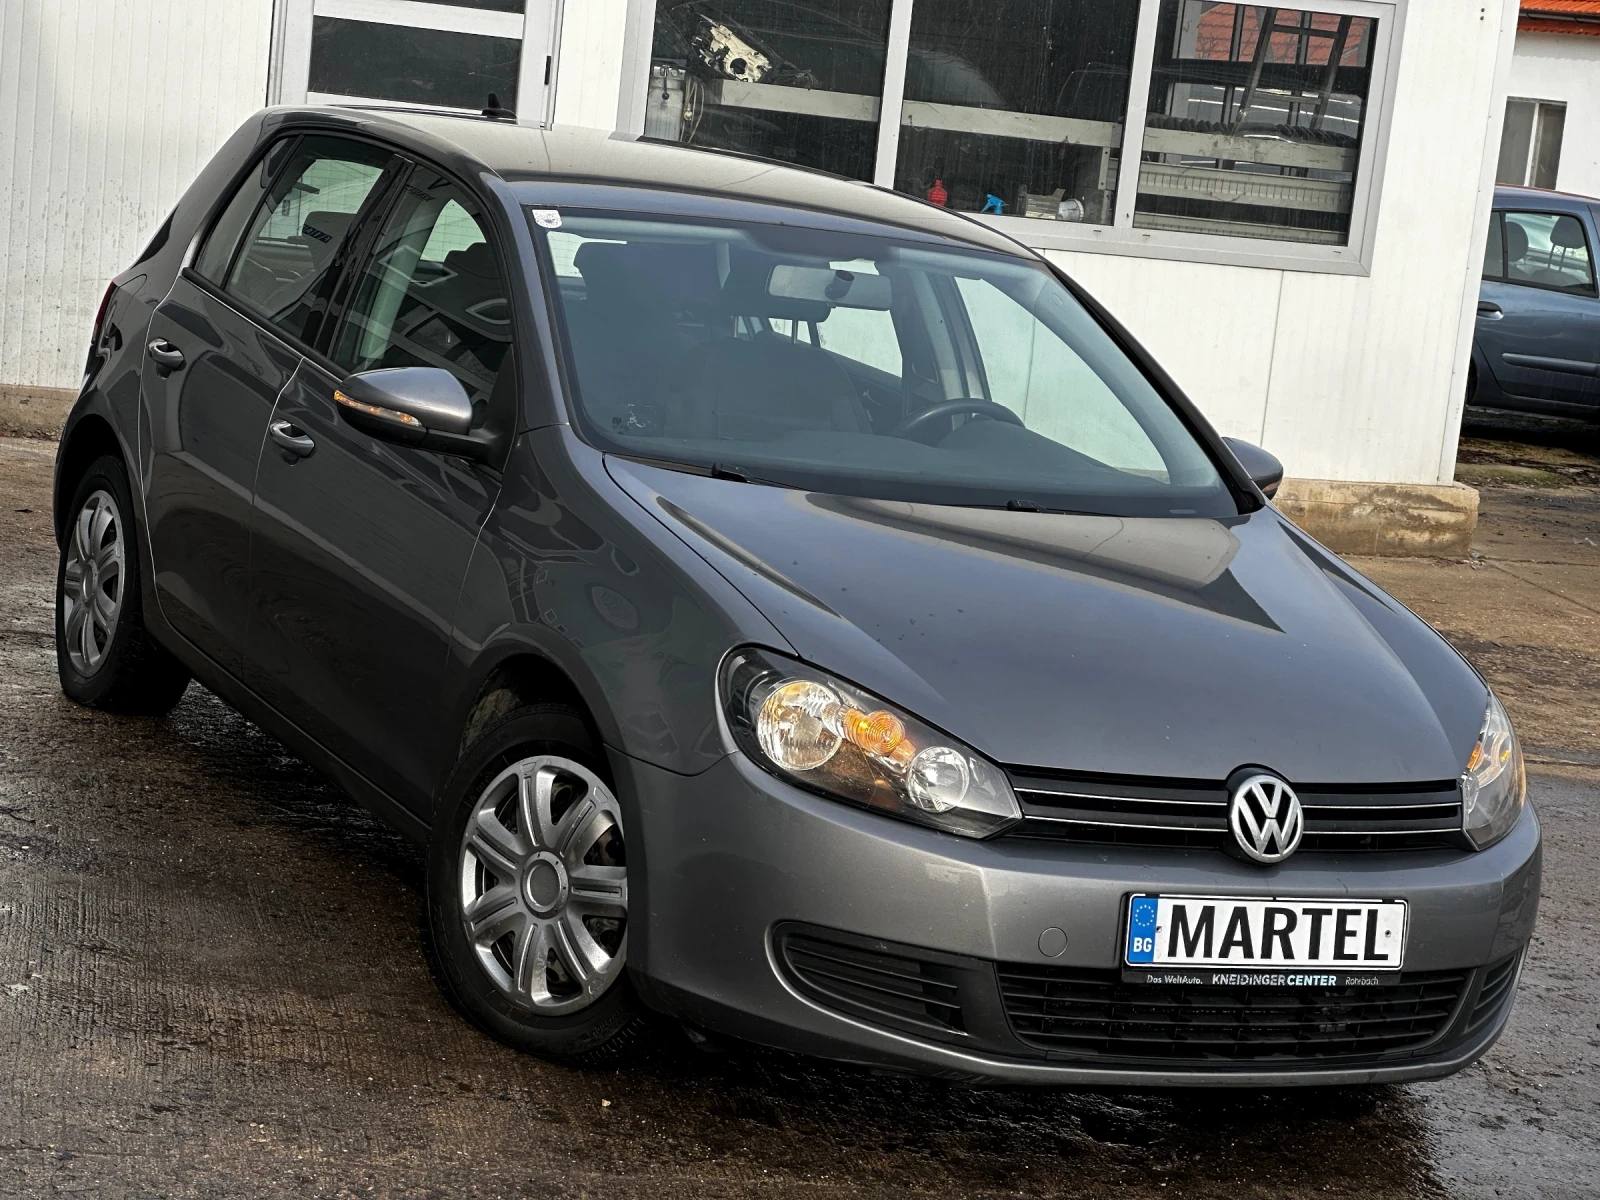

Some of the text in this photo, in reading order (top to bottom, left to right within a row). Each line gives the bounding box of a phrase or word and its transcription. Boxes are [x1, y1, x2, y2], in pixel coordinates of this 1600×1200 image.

[1235, 777, 1301, 860] VW
[1133, 937, 1153, 953] BG
[1167, 904, 1389, 961] MARTEL
[1146, 974, 1162, 984] Das
